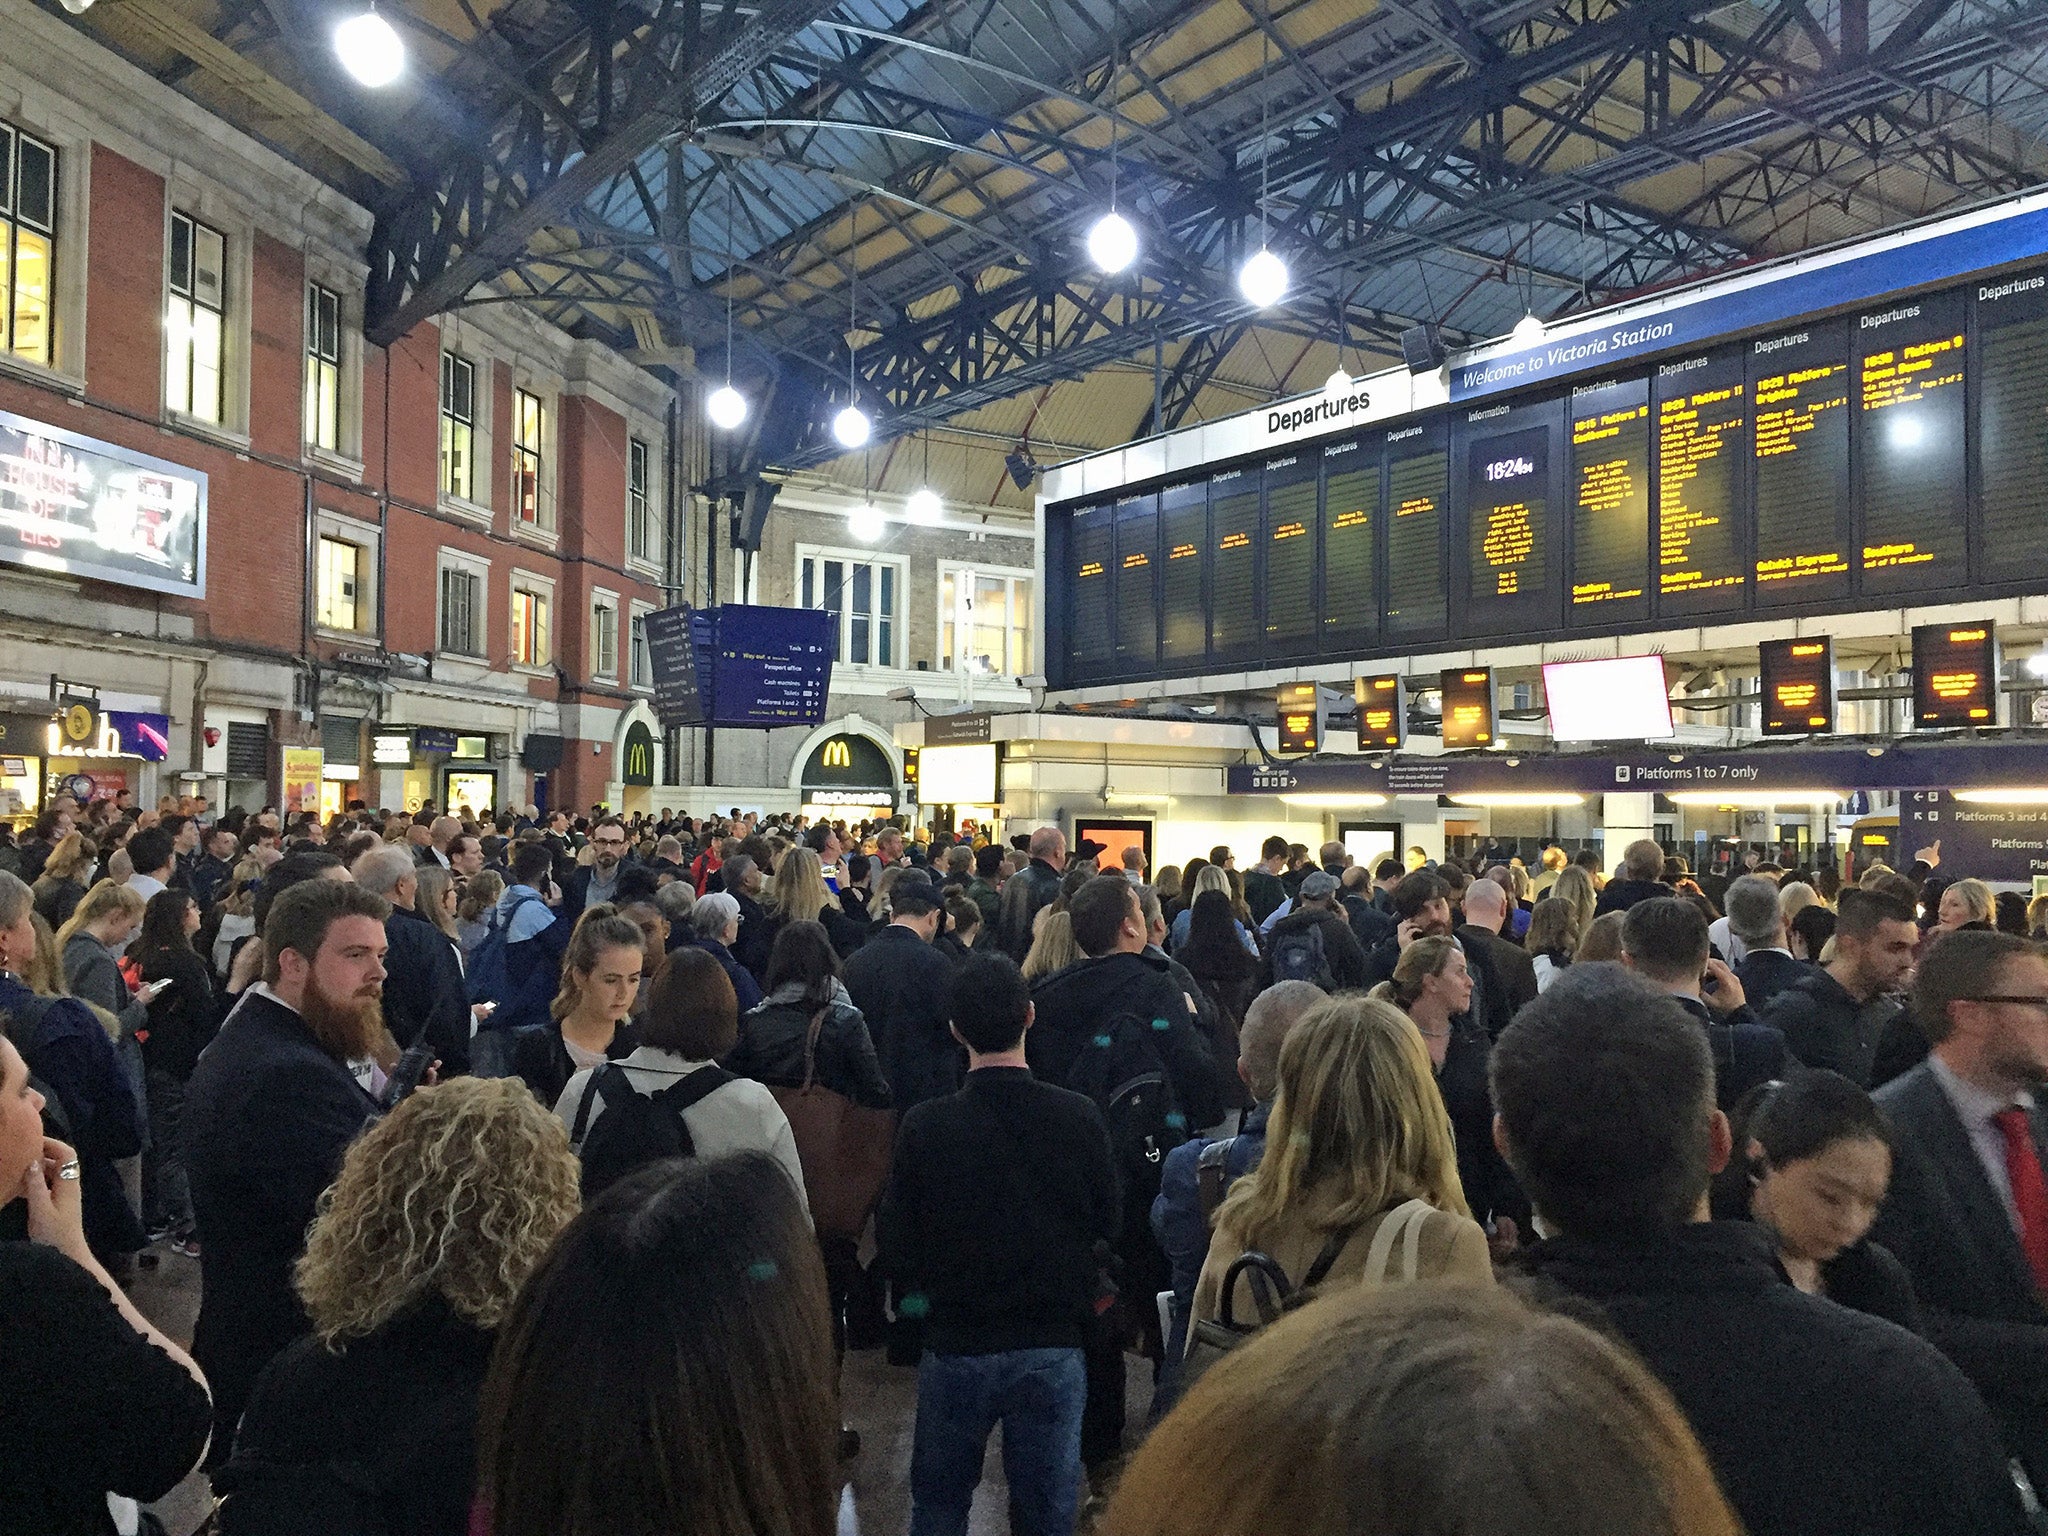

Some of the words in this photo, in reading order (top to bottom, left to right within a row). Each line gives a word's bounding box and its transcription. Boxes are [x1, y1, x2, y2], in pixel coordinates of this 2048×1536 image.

[1979, 276, 2045, 301] Departures
[1861, 306, 1920, 328] Departures
[1755, 332, 1809, 353] Departures
[1904, 341, 1950, 359] Platform
[1954, 336, 1962, 347] 9
[1464, 361, 1524, 389] Welcome
[1528, 356, 1543, 370] to
[1548, 338, 1607, 366] Victoria
[1611, 322, 1673, 350] Station
[1660, 357, 1708, 376] Departures
[1788, 367, 1831, 385] Platform
[1863, 368, 1895, 382] Epsom
[1573, 380, 1617, 397] Departures
[1756, 388, 1798, 405] Brighton
[1692, 390, 1731, 406] Platform
[1268, 392, 1370, 434] Departures
[1469, 405, 1510, 422] Information
[1601, 411, 1636, 425] Platform
[1786, 413, 1814, 425] Airport
[1388, 426, 1422, 442] Departures
[1673, 421, 1699, 432] Dorking
[1688, 434, 1718, 444] Junction
[1325, 442, 1357, 456] Departures
[1688, 451, 1717, 461] Junction
[1266, 457, 1297, 471] Departures
[1212, 470, 1241, 483] Departures
[29, 499, 57, 518] OF
[18, 530, 62, 548] LIES
[1636, 767, 1692, 779] Platforms
[1695, 766, 1700, 778] 1
[1703, 767, 1716, 778] to
[1720, 766, 1727, 777] 7
[1731, 765, 1758, 780] only
[1956, 812, 2005, 821] Platforms
[2007, 812, 2014, 821] 3
[2017, 812, 2036, 821] and
[2040, 812, 2047, 820] 4
[1992, 838, 2043, 848] Platforms
